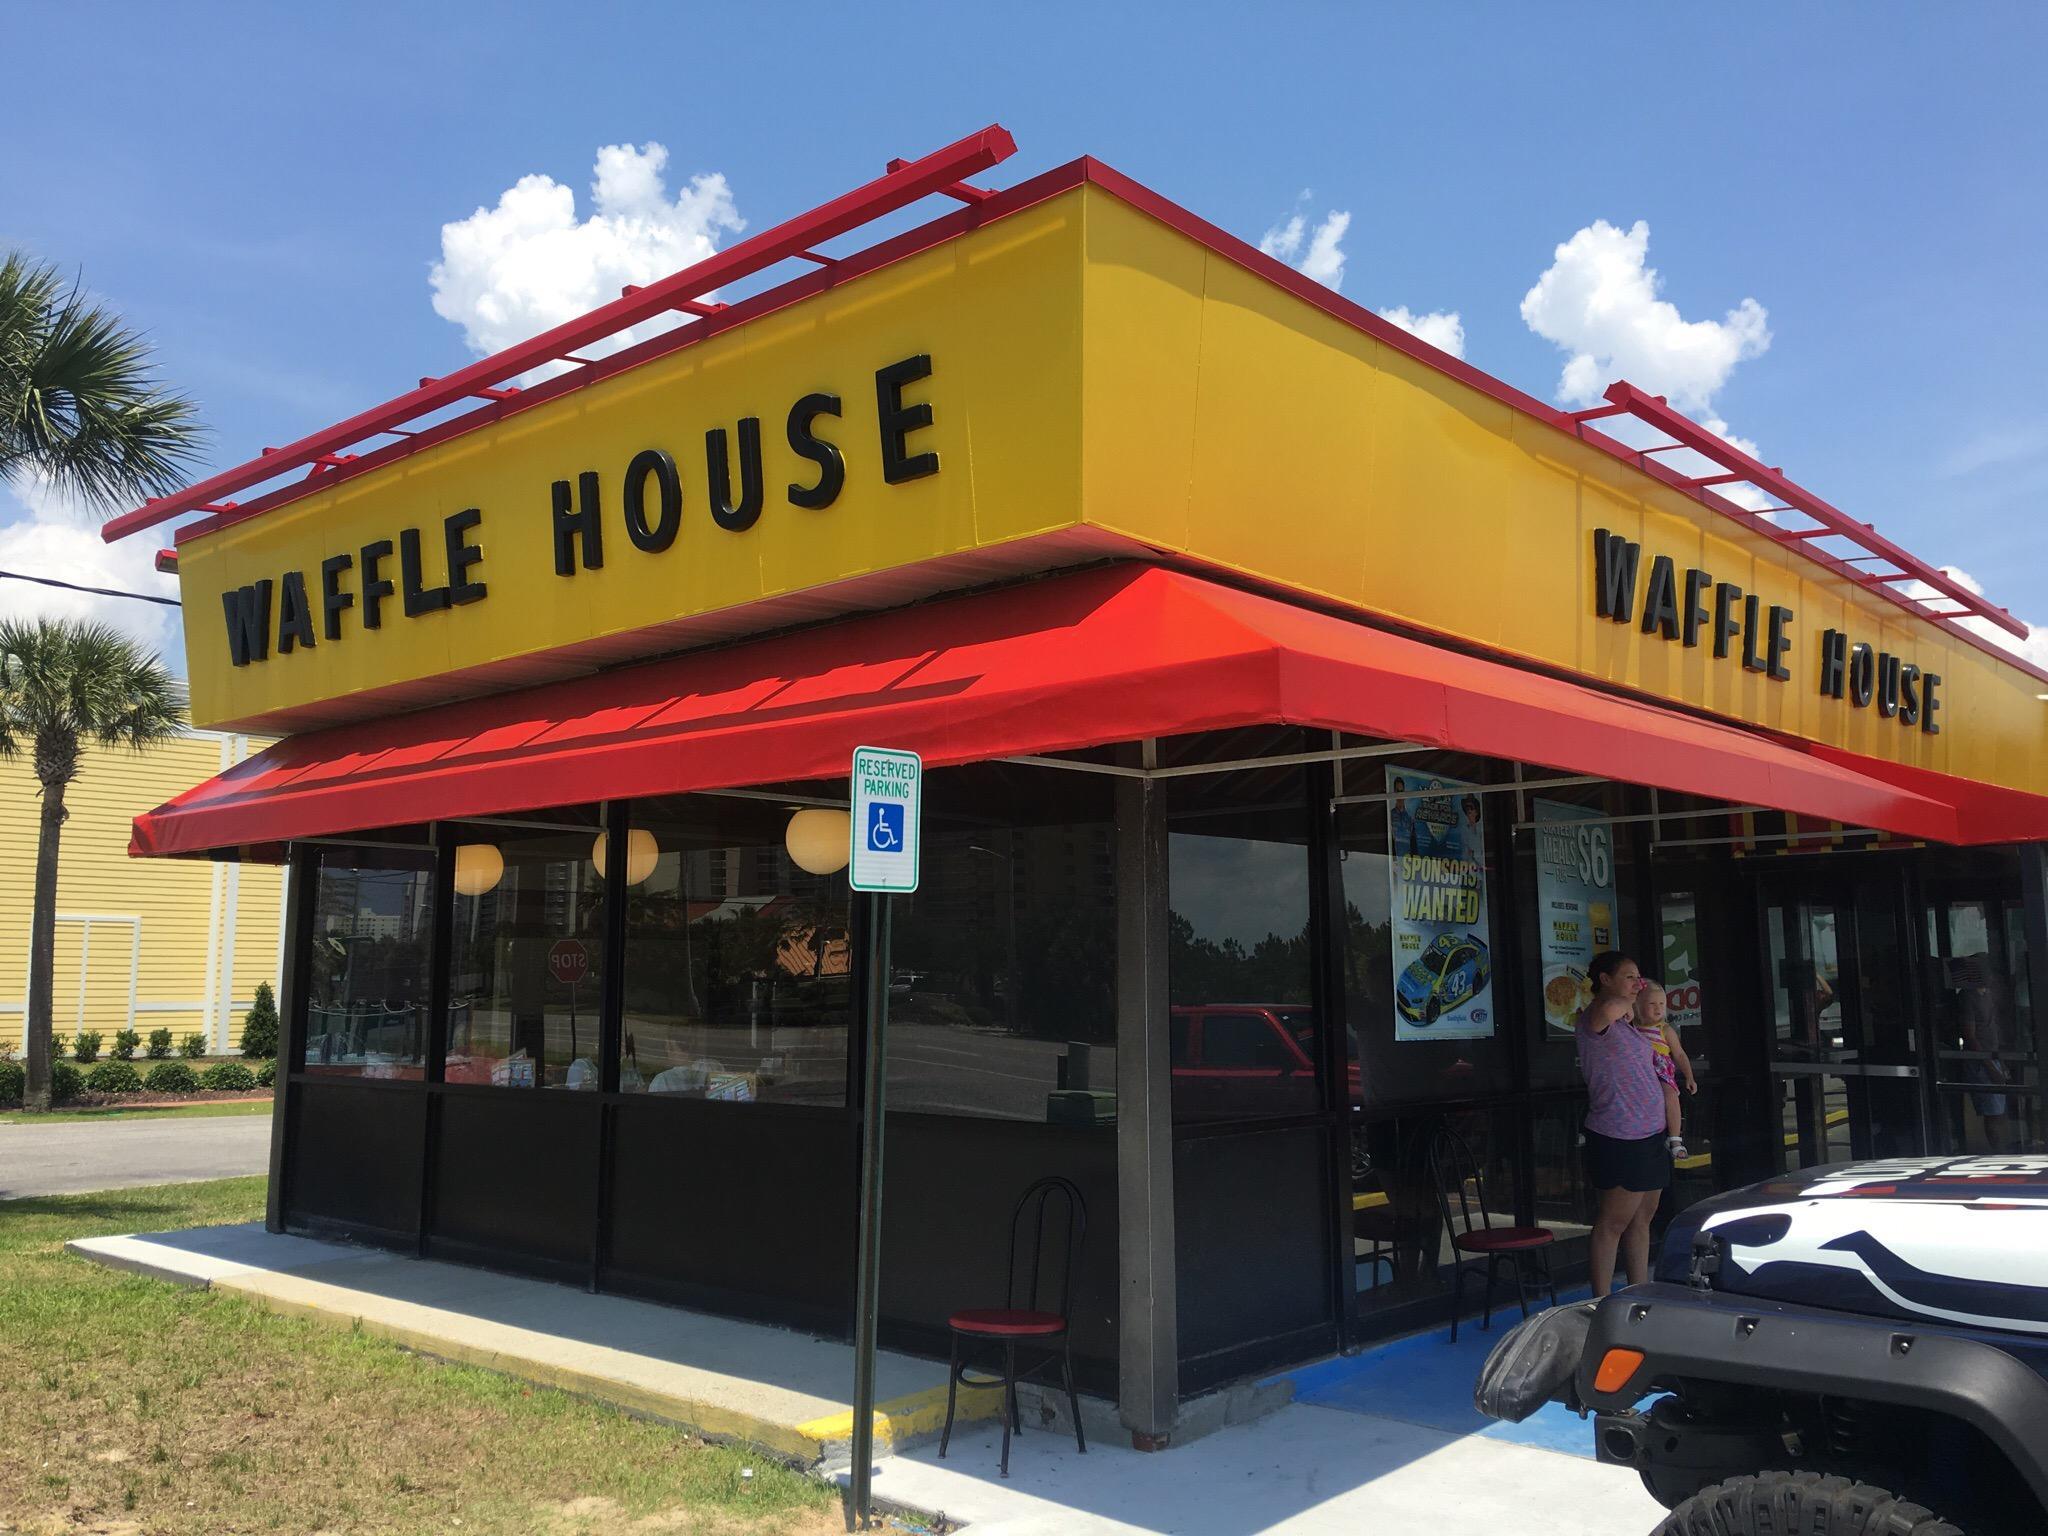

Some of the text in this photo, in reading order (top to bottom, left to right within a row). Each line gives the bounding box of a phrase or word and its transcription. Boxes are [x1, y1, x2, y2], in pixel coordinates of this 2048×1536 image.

[222, 354, 941, 667] WAFFLE HOUSE
[1594, 528, 1942, 735] WAFFLE HOUSE
[859, 758, 916, 780] RESERVED
[864, 778, 909, 799] PARKING
[1543, 836, 1577, 866] MEALS
[1576, 823, 1609, 888] $6
[1402, 853, 1478, 888] SPONSORS
[1403, 884, 1480, 925] WANTED
[1451, 971, 1466, 996] 43
